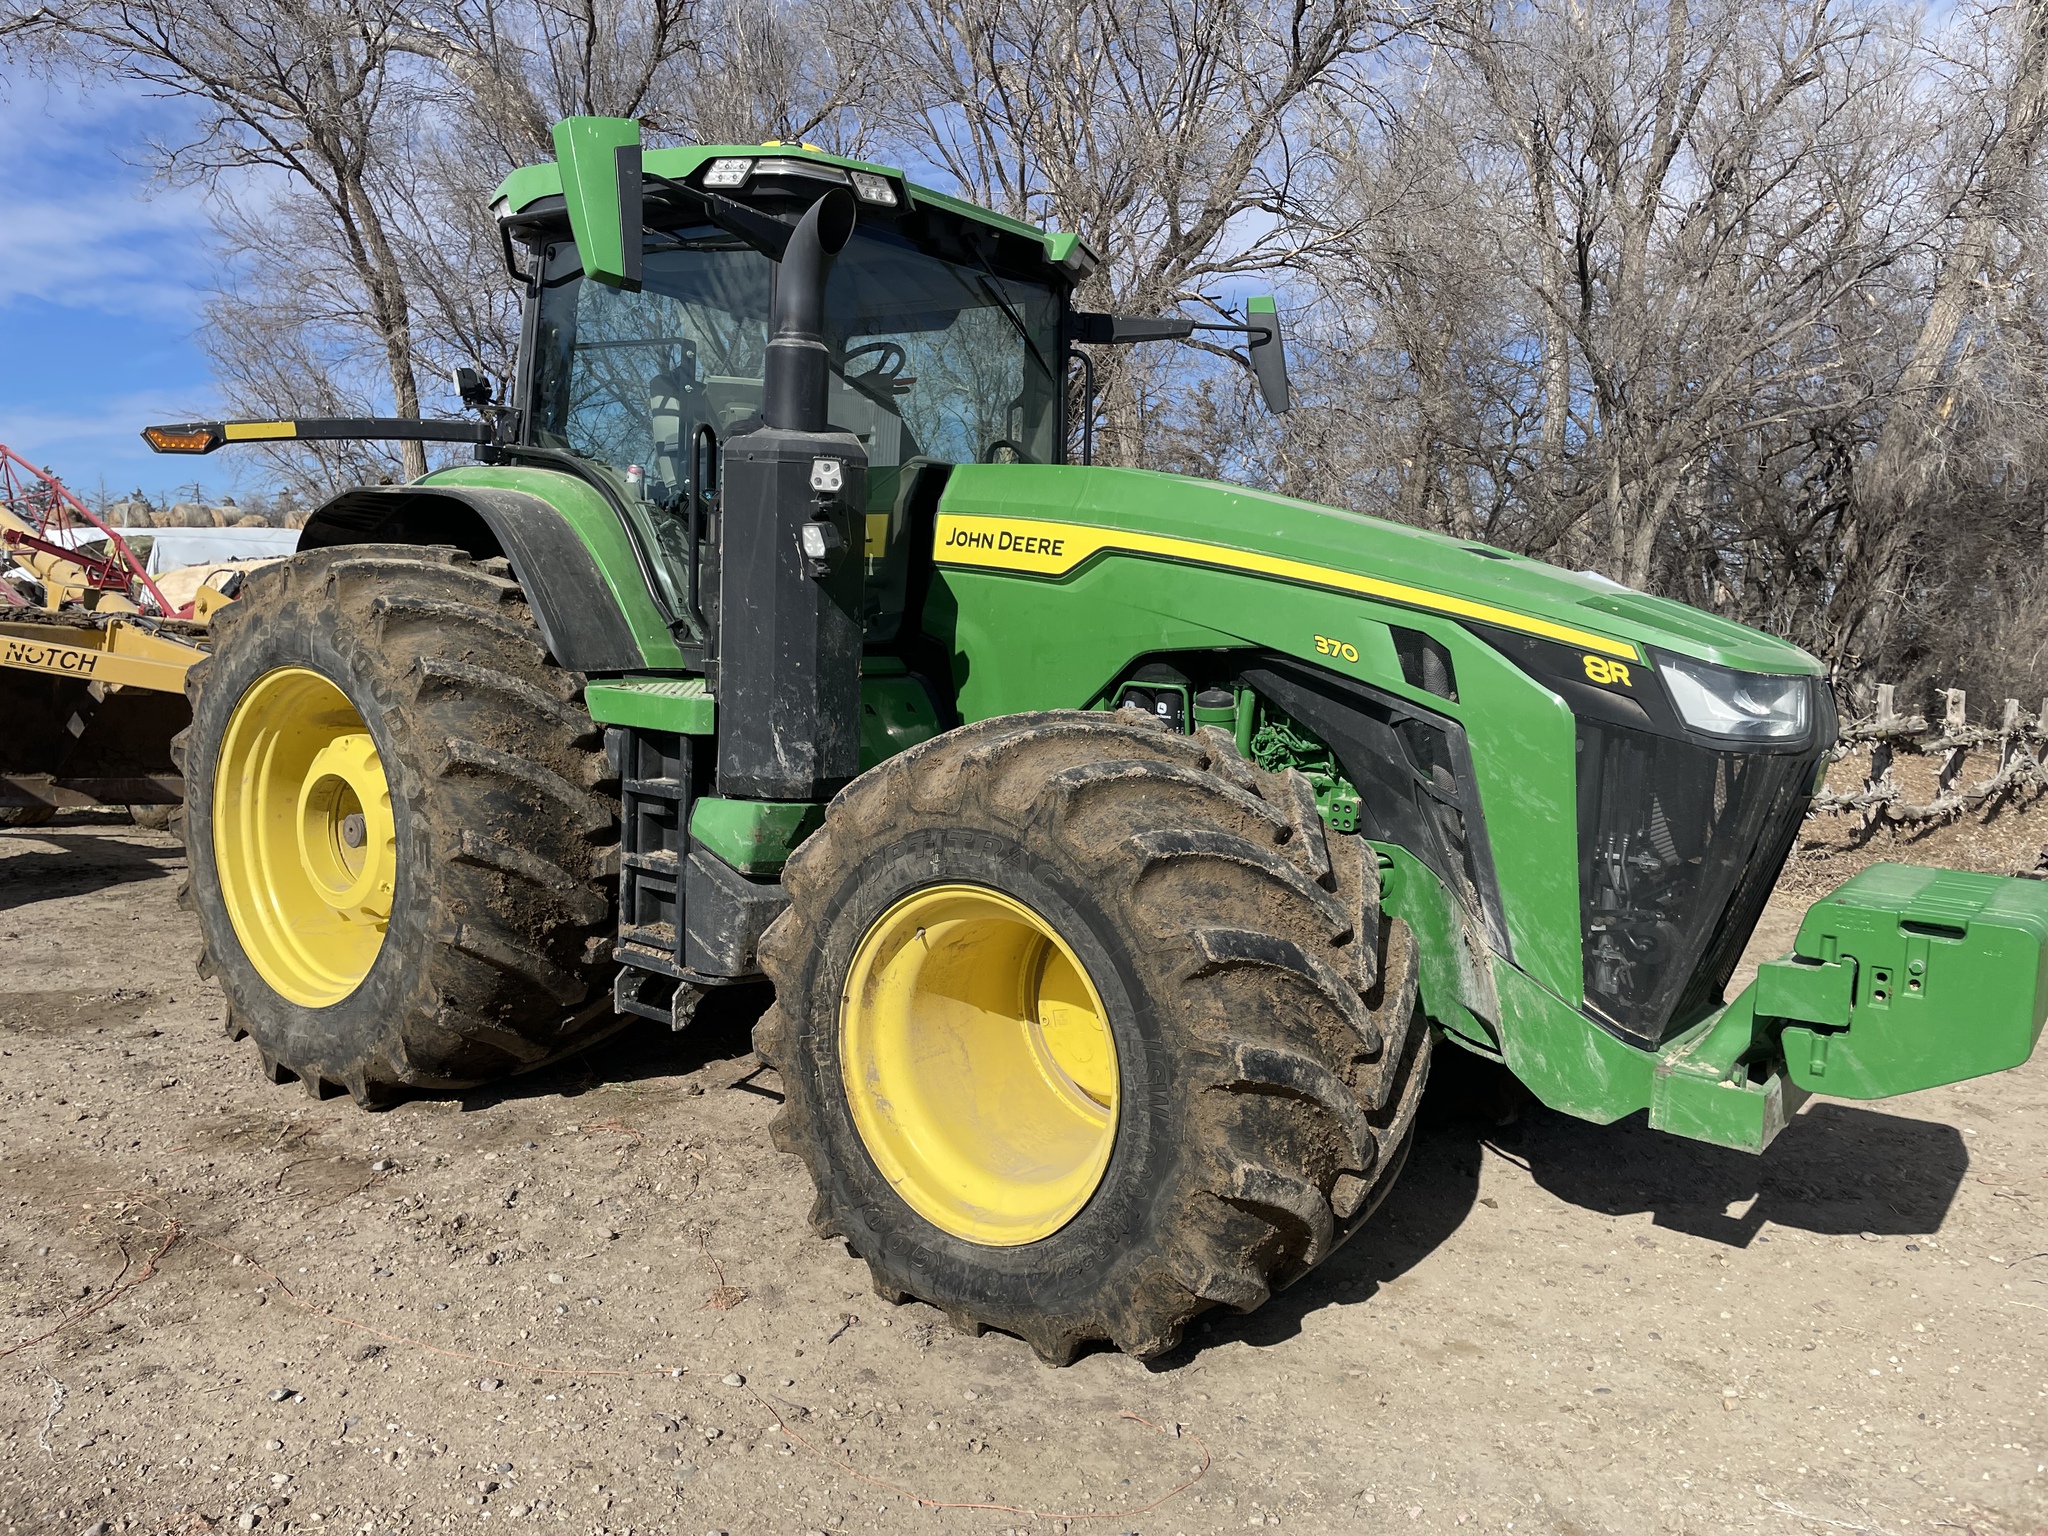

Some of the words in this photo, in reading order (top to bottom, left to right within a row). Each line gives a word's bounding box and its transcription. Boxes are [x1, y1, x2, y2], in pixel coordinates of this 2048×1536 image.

[945, 527, 995, 549] JOHN
[998, 531, 1065, 556] DEERE
[5, 642, 98, 672] NOTCH
[1313, 634, 1359, 664] 370
[1583, 655, 1633, 687] 8R
[863, 831, 1062, 888] OPTITRAC
